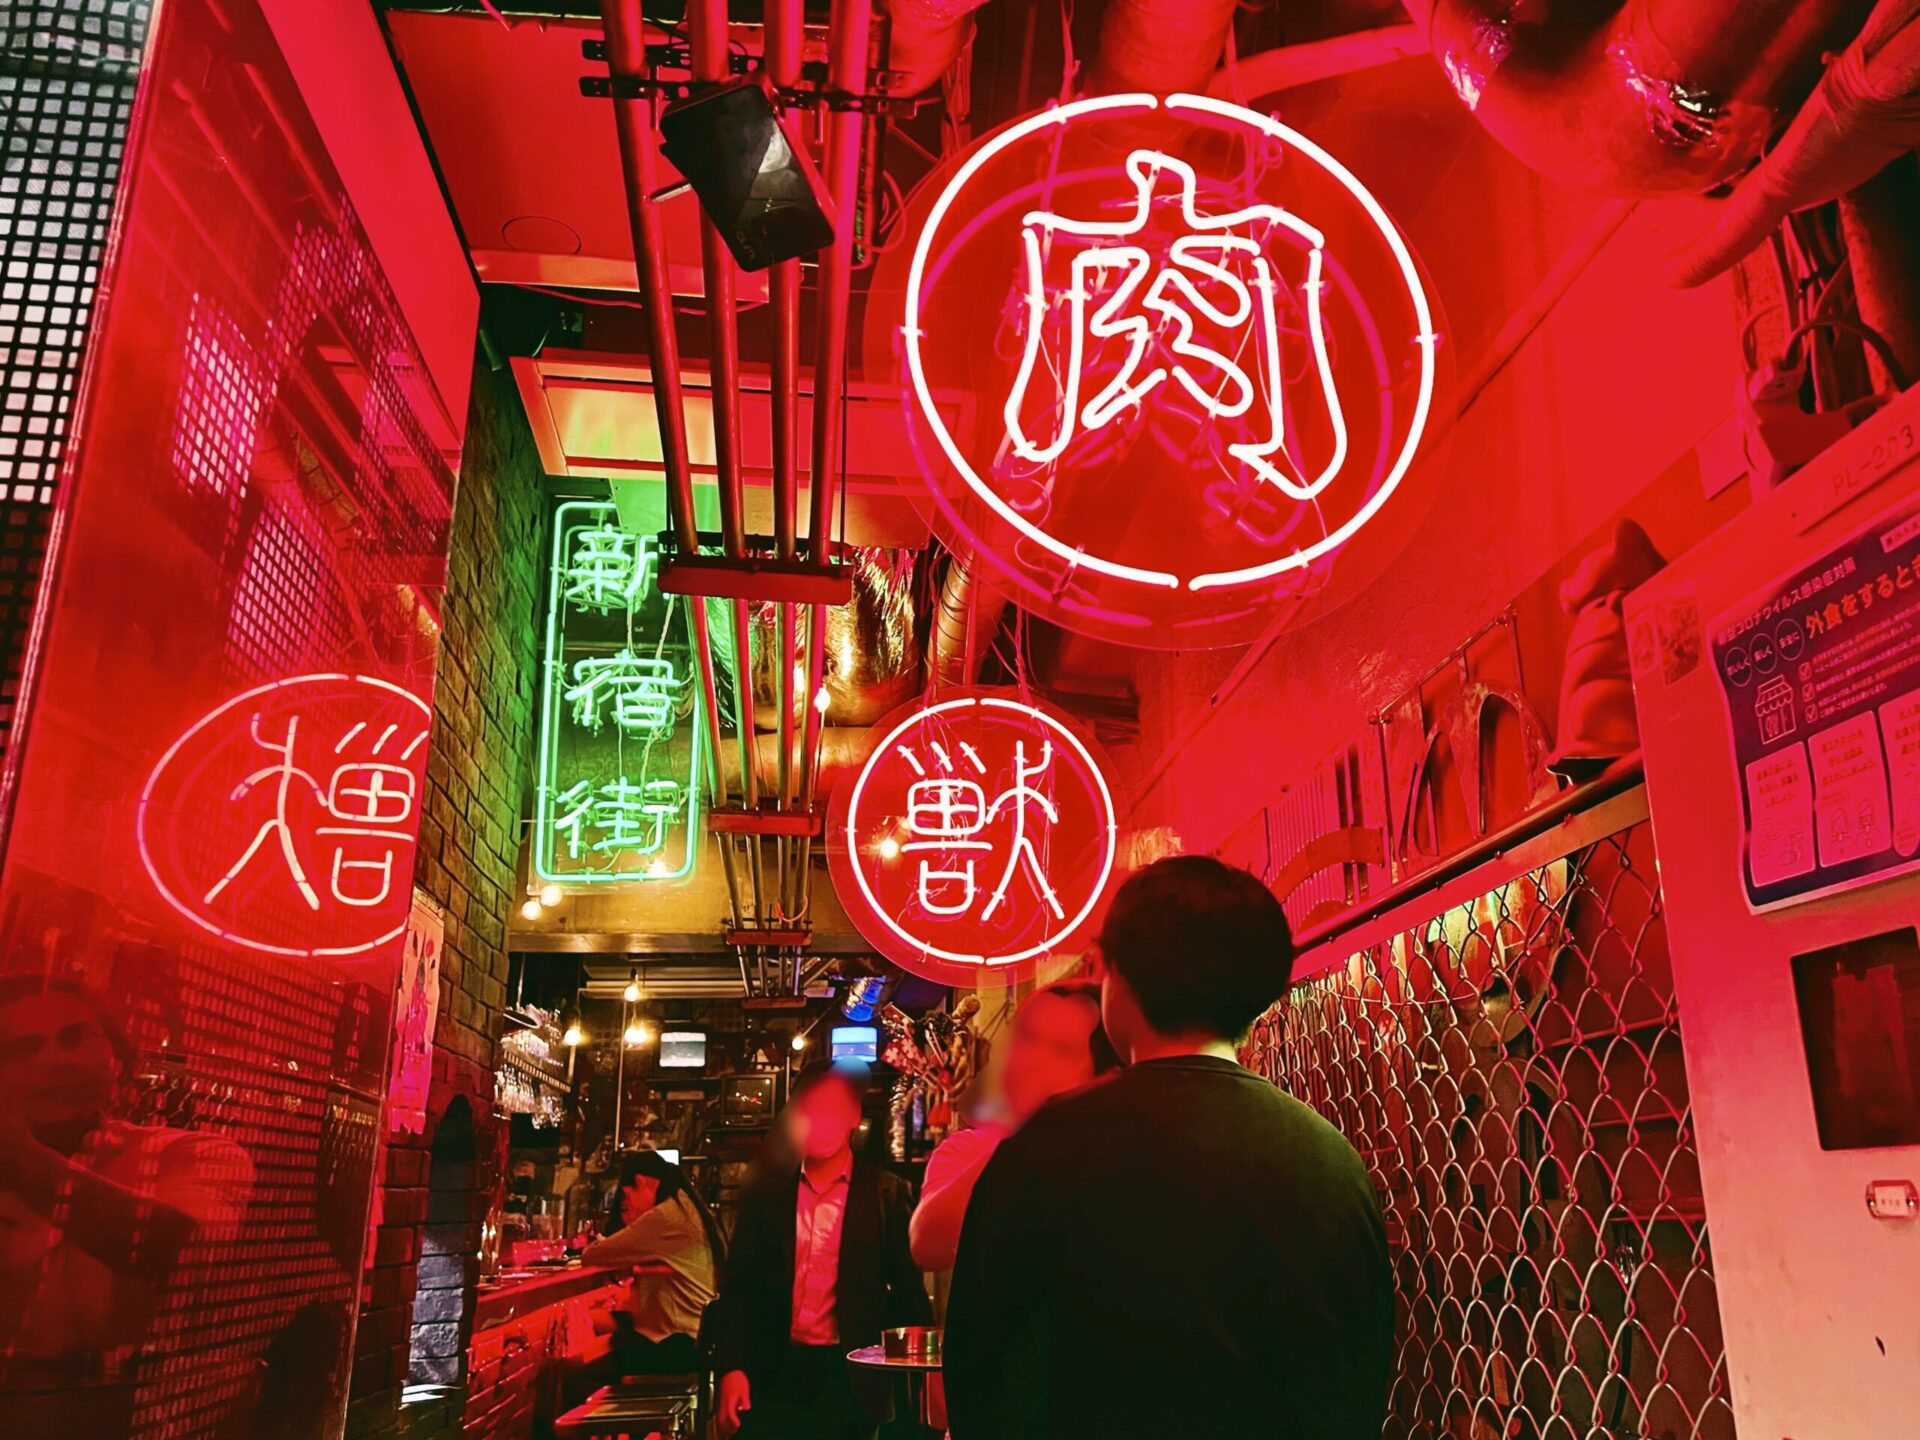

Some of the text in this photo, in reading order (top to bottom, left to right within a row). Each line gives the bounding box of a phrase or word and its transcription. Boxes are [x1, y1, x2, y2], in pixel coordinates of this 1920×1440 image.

[1003, 149, 1348, 500] 肉
[554, 523, 681, 861] 新宿街
[896, 739, 1065, 922] 獣
